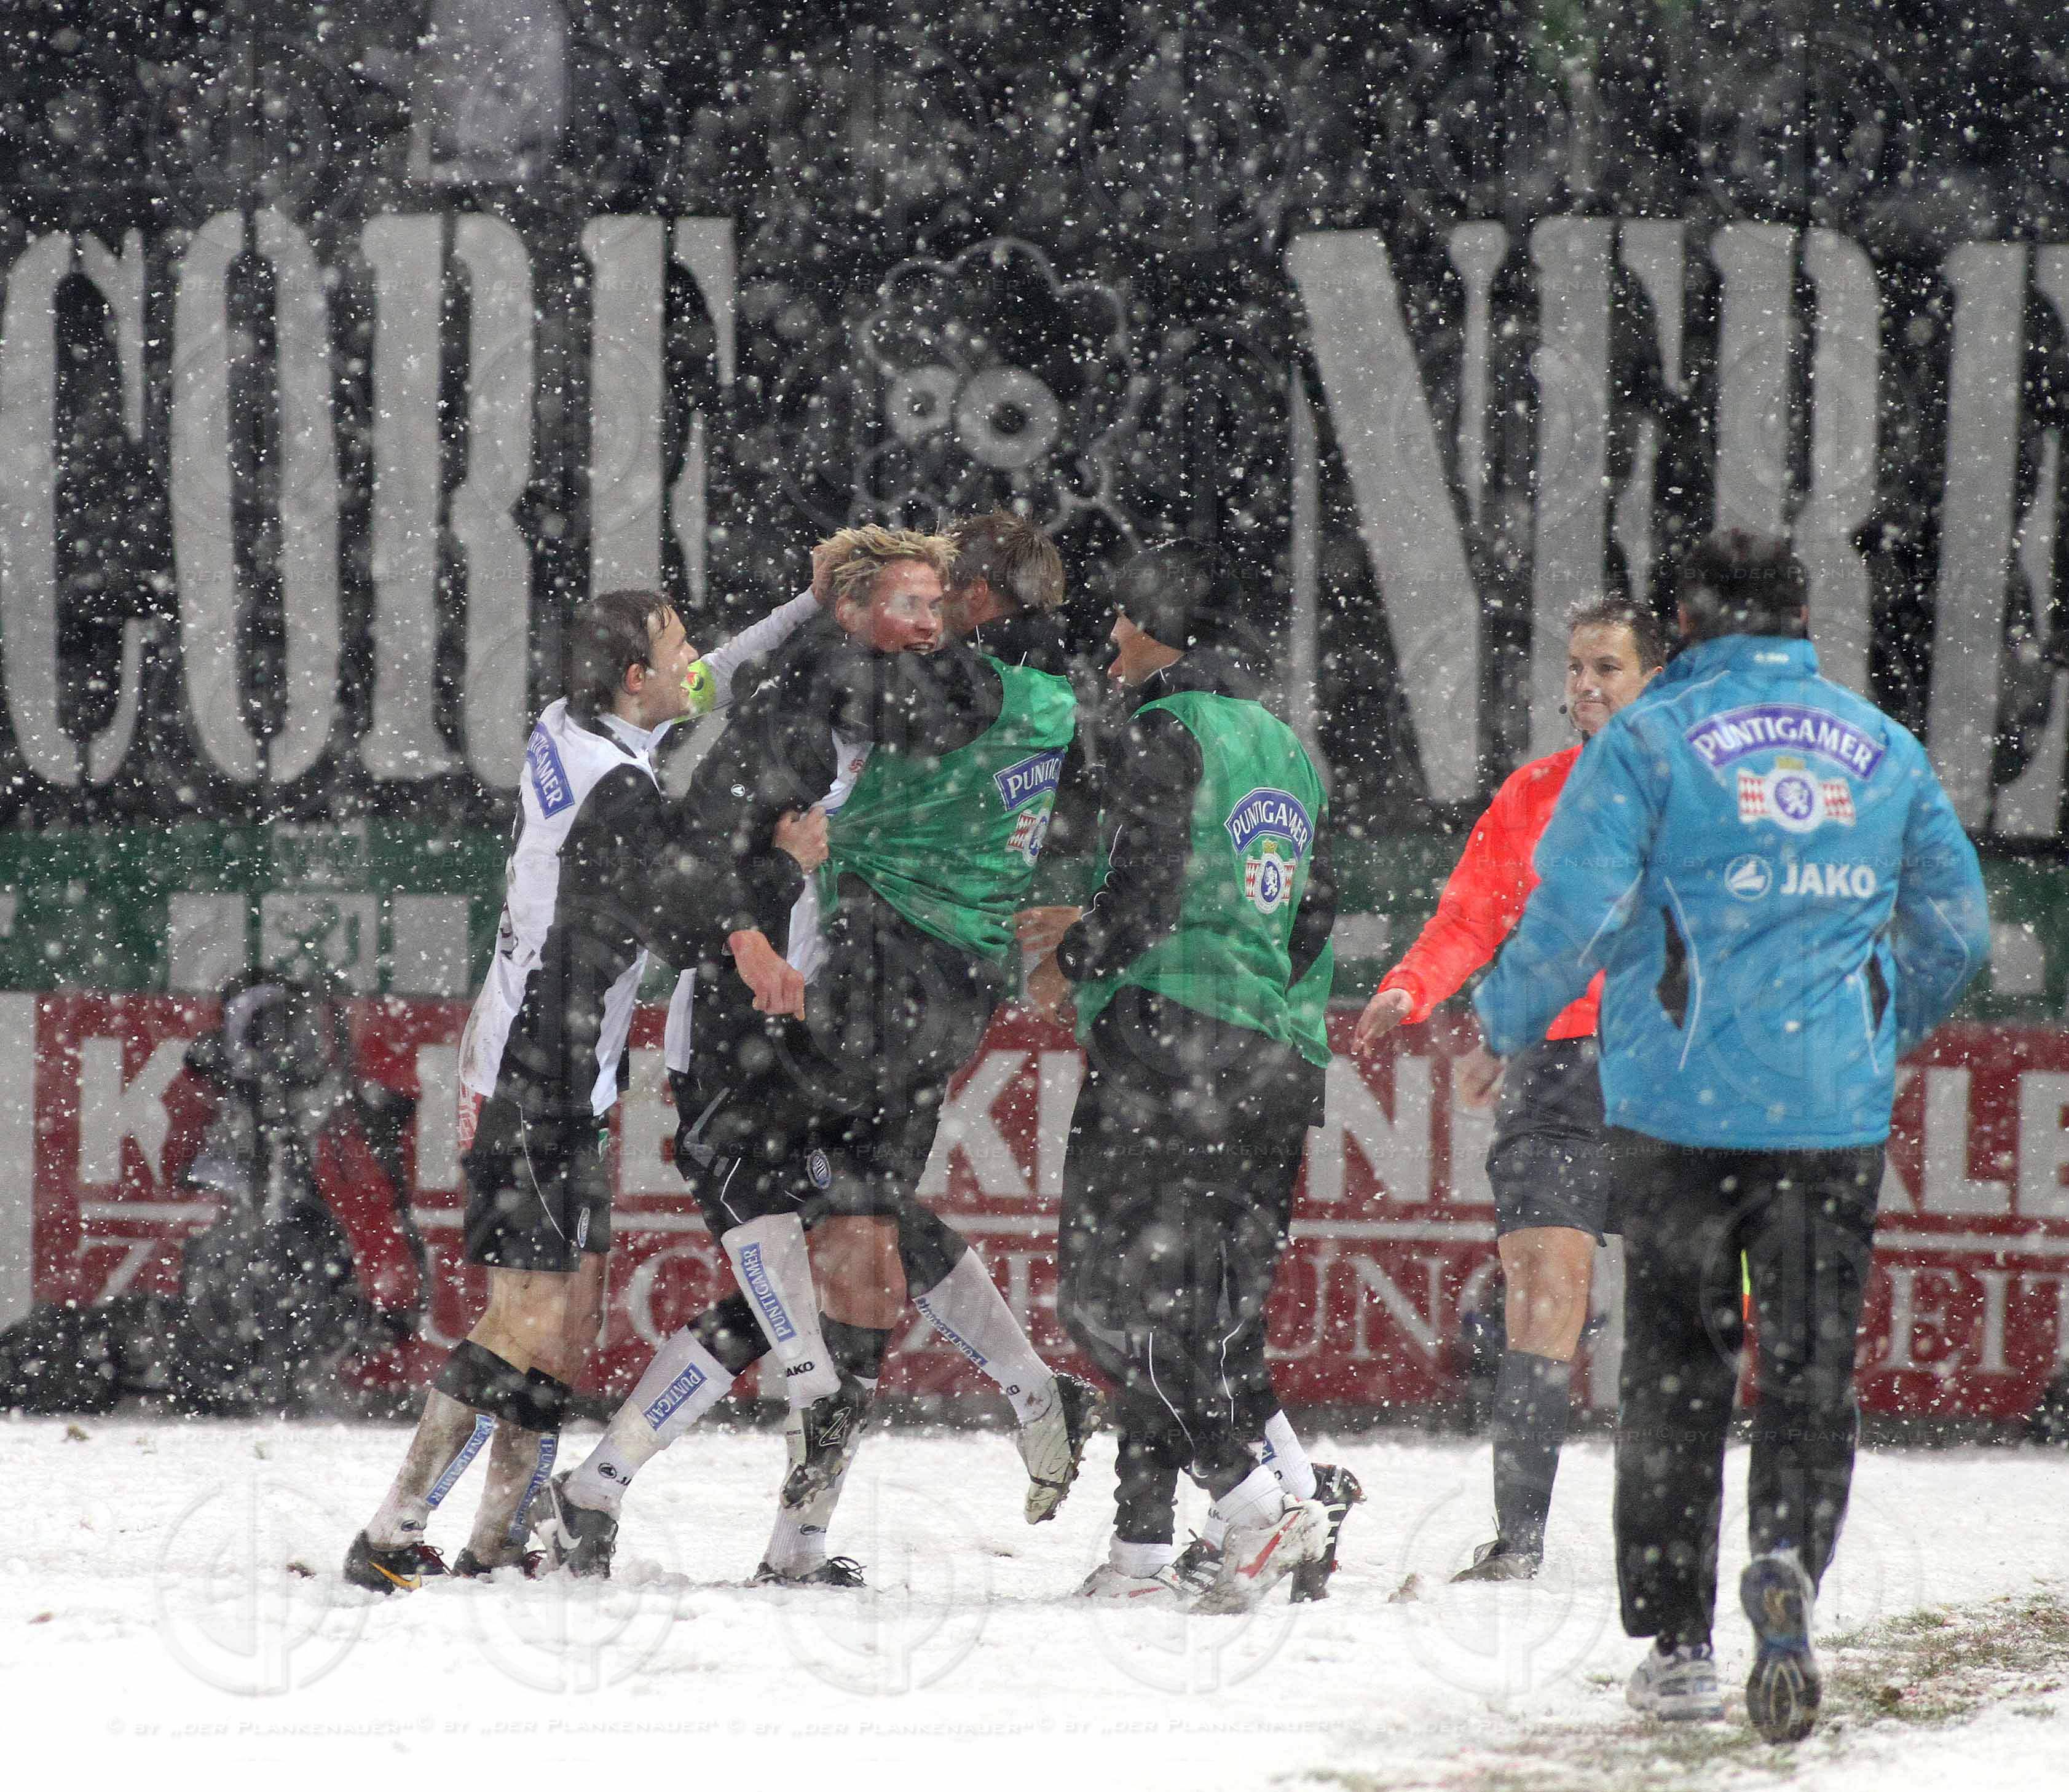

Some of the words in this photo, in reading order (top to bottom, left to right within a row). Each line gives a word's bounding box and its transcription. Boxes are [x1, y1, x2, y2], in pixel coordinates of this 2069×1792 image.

[1693, 716, 1874, 772] PUNTIGAMER
[1780, 863, 1877, 898] JAKO
[741, 1248, 794, 1341] PUNTIGAMER
